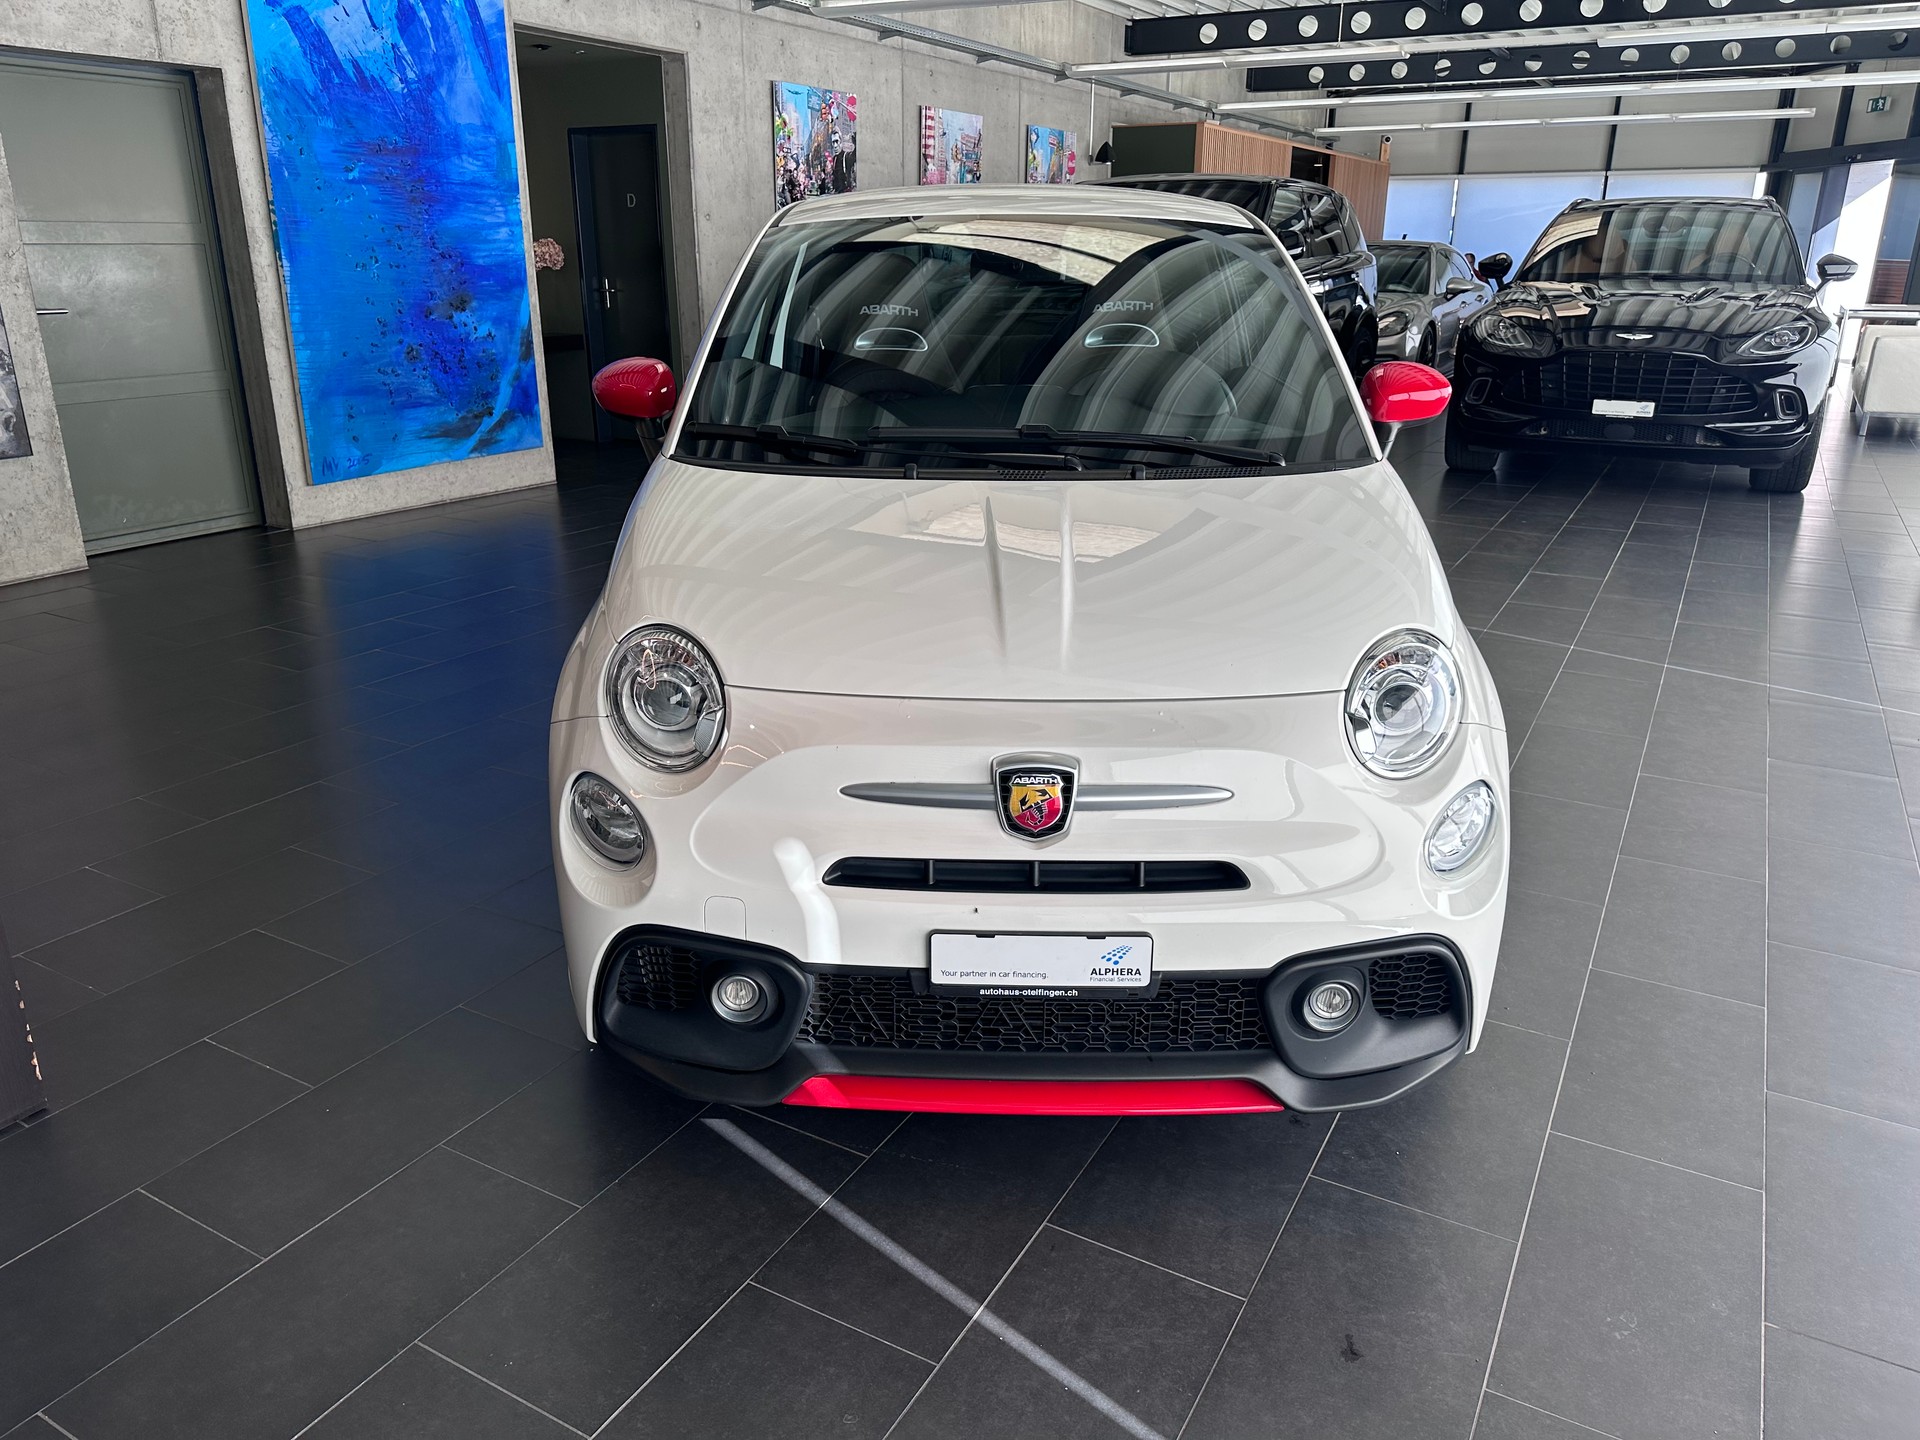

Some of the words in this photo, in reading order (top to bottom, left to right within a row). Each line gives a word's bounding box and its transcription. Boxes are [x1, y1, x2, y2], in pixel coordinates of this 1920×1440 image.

[626, 193, 637, 208] D
[859, 304, 919, 317] ABARTH
[1093, 300, 1154, 313] ABARTH
[1013, 776, 1057, 784] ABARTH
[940, 969, 958, 978] Your
[959, 970, 987, 979] partner
[989, 970, 997, 978] in
[1012, 970, 1049, 980] financing.
[1090, 967, 1142, 976] ALPHERA
[979, 988, 1078, 997] autohaus-otelfingen.ch
[815, 998, 1246, 1045] ABARTH
